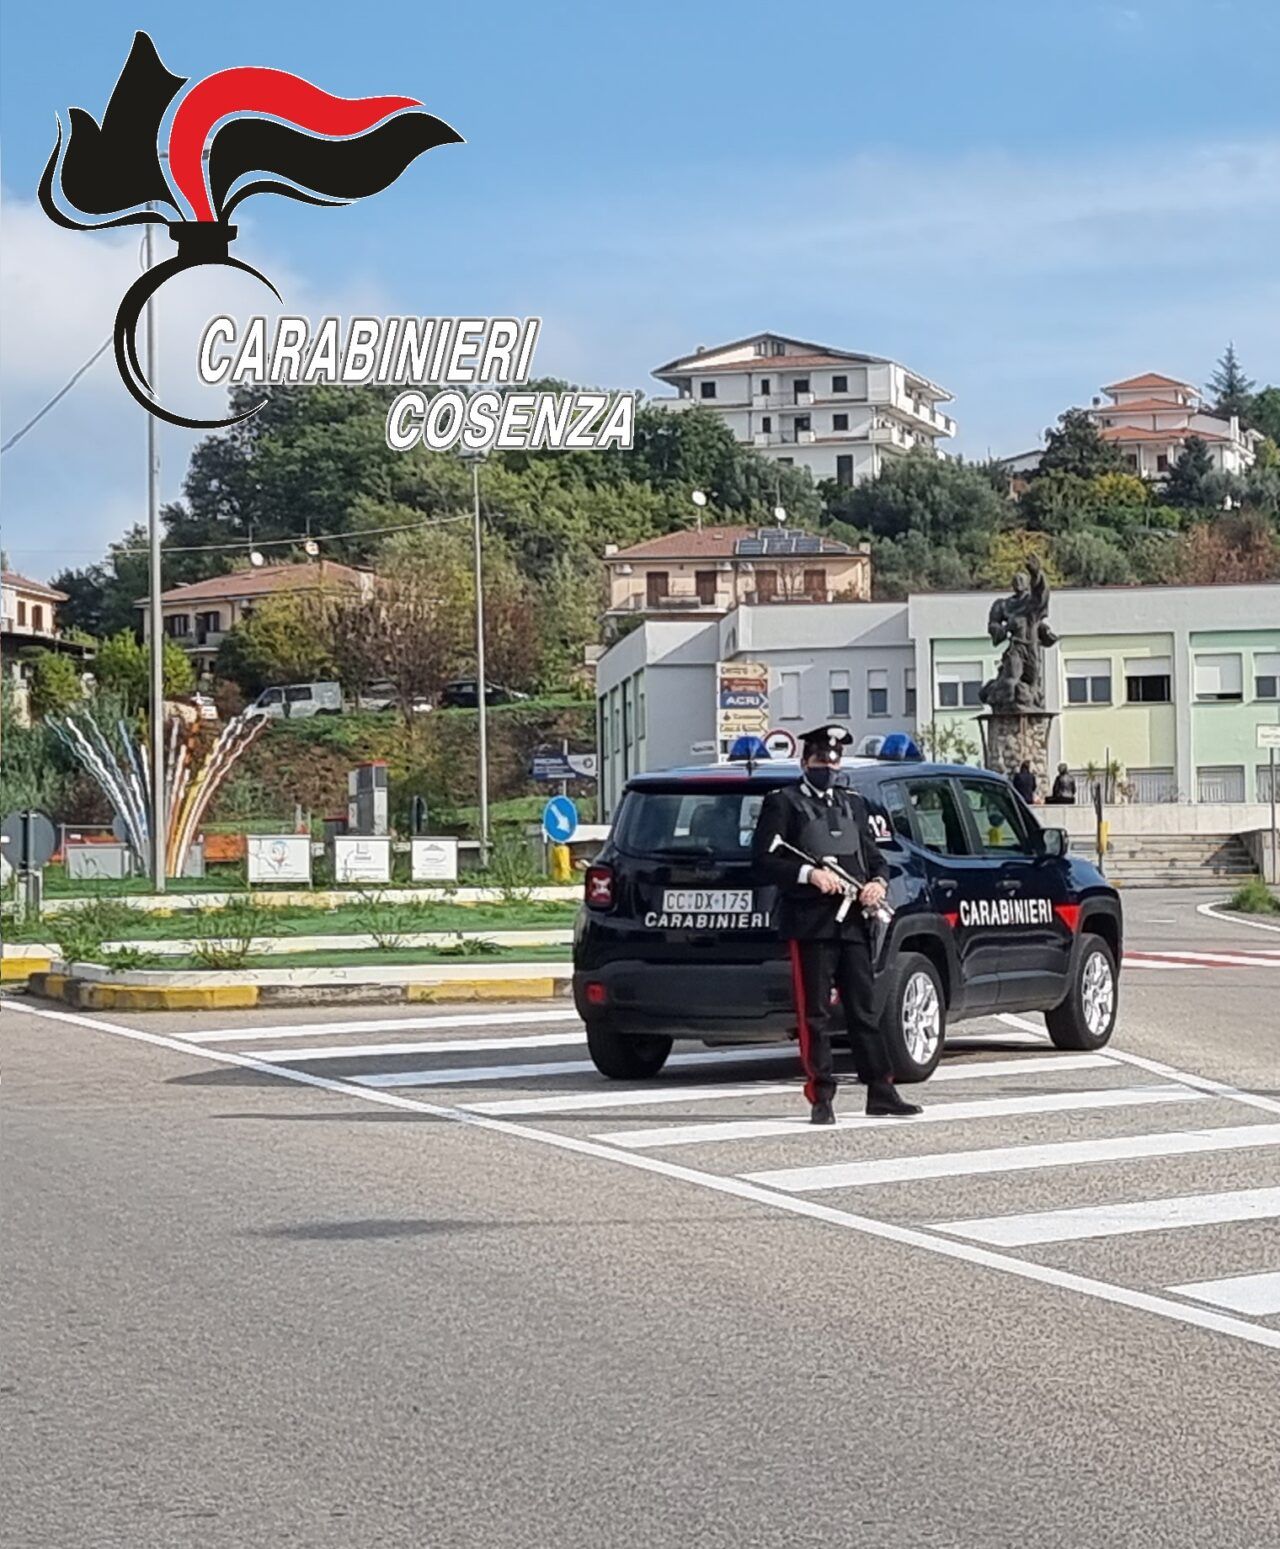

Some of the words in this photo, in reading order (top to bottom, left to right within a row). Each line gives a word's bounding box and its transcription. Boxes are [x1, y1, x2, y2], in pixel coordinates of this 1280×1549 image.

[725, 696, 760, 705] ACRI
[722, 892, 749, 910] 175
[644, 911, 770, 929] CARABINIERI
[960, 898, 1053, 927] CARABINIERI
